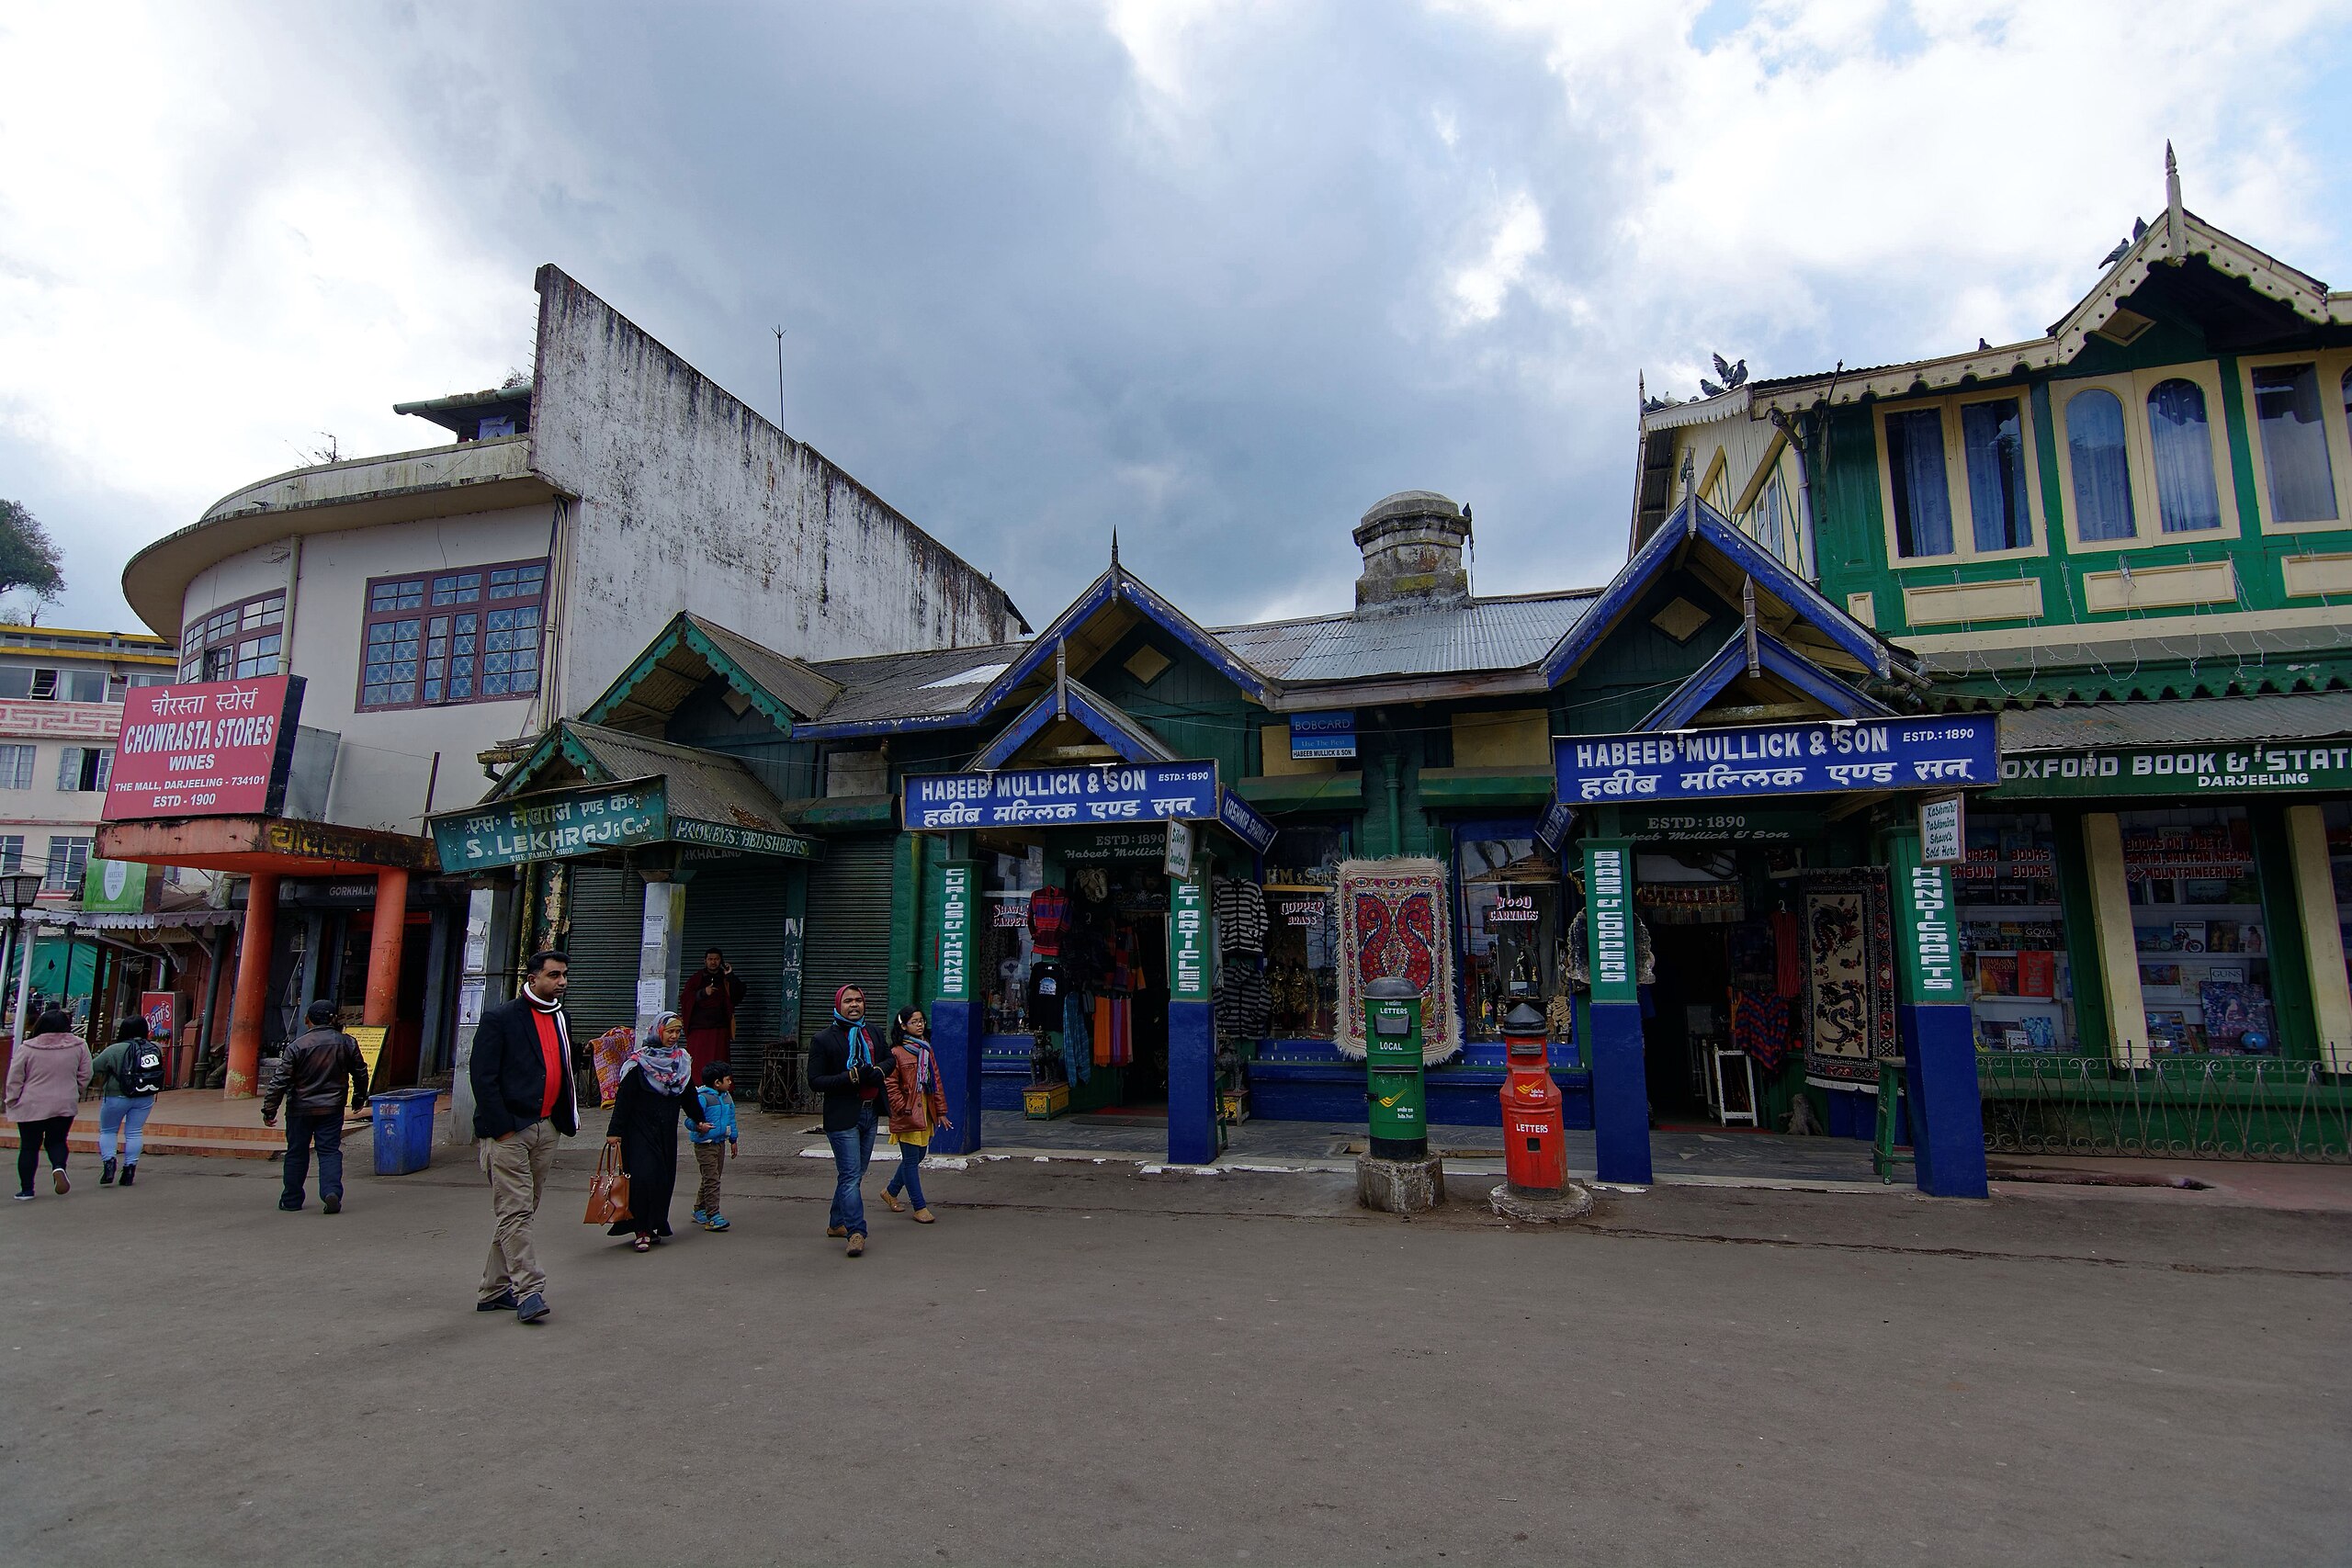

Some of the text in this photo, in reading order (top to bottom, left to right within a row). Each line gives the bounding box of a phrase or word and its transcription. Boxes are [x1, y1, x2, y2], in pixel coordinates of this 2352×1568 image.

[151, 685, 259, 716] चौरस्ता स्टोर्स
[1295, 719, 1351, 731] BOBCARD
[124, 715, 275, 754] CHOWRASTA STORES
[1293, 750, 1314, 758] HABEEB
[1577, 739, 1675, 768] HABEEB
[1685, 731, 1802, 762] MULLICK
[1809, 730, 1828, 755] &
[1838, 727, 1889, 754] SON
[1945, 728, 1974, 739] 1890
[169, 753, 215, 772] WINES
[2001, 748, 2352, 780] OXFORD BOOK & STAT
[115, 783, 132, 792] THE
[134, 780, 162, 792] MALL,
[164, 777, 223, 790] DARJEELING
[231, 775, 266, 786] 734101
[922, 778, 989, 801] HABEEB
[996, 773, 1080, 797] MULLICK
[1086, 773, 1100, 794] &
[1105, 770, 1147, 793] SON
[1186, 772, 1209, 781] 1890
[1577, 758, 1974, 799] हबीब मल्लिक एण्ड सन्
[2198, 773, 2310, 787] DARJEELING
[153, 795, 181, 808] ESTD
[190, 793, 217, 806] 1900
[922, 796, 1196, 828] हबीब मल्लिक एण्ड सन्
[466, 839, 493, 859] S.
[496, 820, 612, 855] LEKHRAJ
[2126, 838, 2165, 852] BOOKS
[2167, 837, 2184, 851] ON
[527, 850, 553, 861] FAMILY
[555, 847, 574, 855] SHOP
[1065, 849, 1111, 859] Habeeb
[1926, 845, 1957, 859] Sold Here
[2010, 849, 2052, 862] BOOKS
[1594, 851, 1622, 895] BRASS
[1951, 864, 2052, 879] ENGUIN BOOKS
[2145, 866, 2245, 880] MOUNTAINEERING
[944, 868, 965, 919] CURIOS
[1280, 901, 1324, 916] COPPER
[1495, 895, 1532, 909] WOOD
[1287, 915, 1317, 925] BRASS
[1487, 909, 1539, 921] CARVINGS
[1912, 866, 1953, 990] HANDICRAFTS
[2025, 928, 2053, 936] GOYA
[1178, 909, 1200, 992] ARTICLES
[1597, 911, 1626, 983] COPPERS
[943, 932, 964, 993] THANKAS
[2211, 970, 2242, 978] GUNS
[1379, 1041, 1403, 1050] LOCAL
[1516, 1123, 1548, 1133] LETTERS
